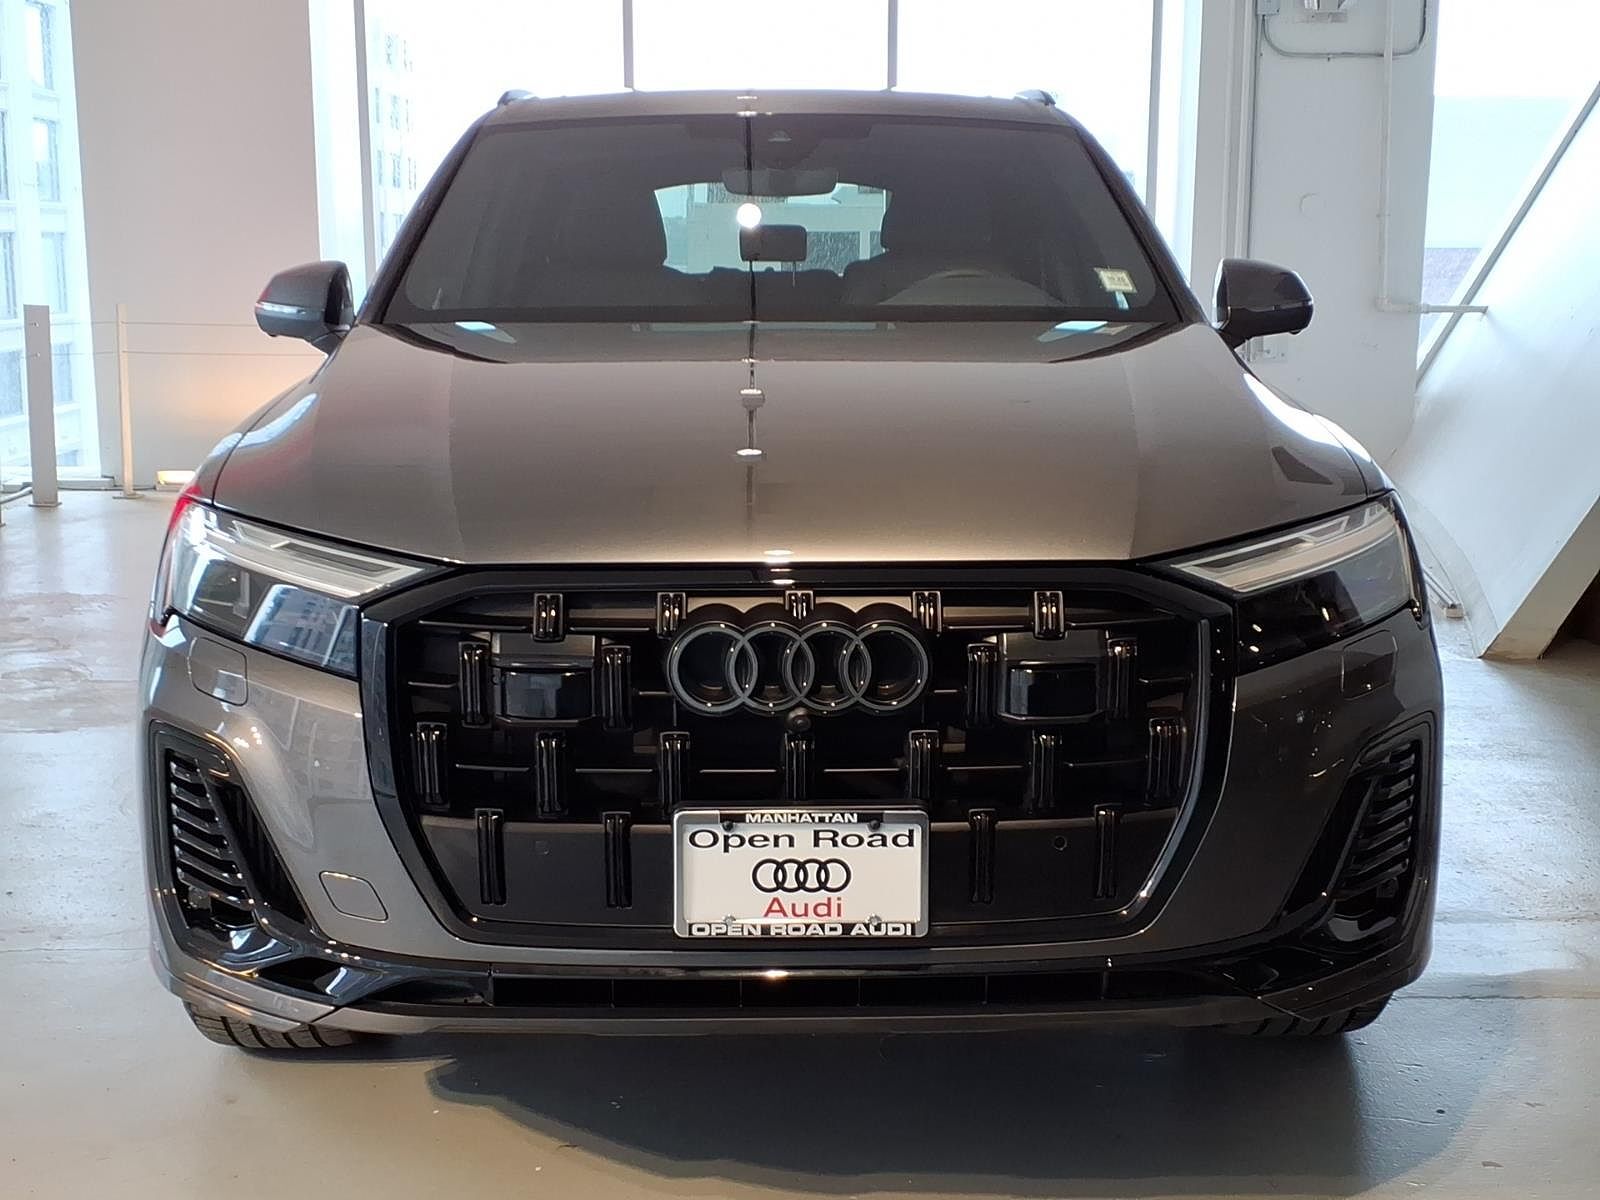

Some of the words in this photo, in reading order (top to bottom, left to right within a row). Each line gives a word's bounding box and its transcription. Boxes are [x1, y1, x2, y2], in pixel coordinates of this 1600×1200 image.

[745, 813, 858, 824] MANHATTAN
[688, 829, 795, 853] Open
[813, 829, 915, 848] Road
[763, 897, 842, 918] Audi
[691, 923, 761, 936] OPEN
[770, 923, 842, 936] ROAD
[851, 923, 911, 936] AUDI
